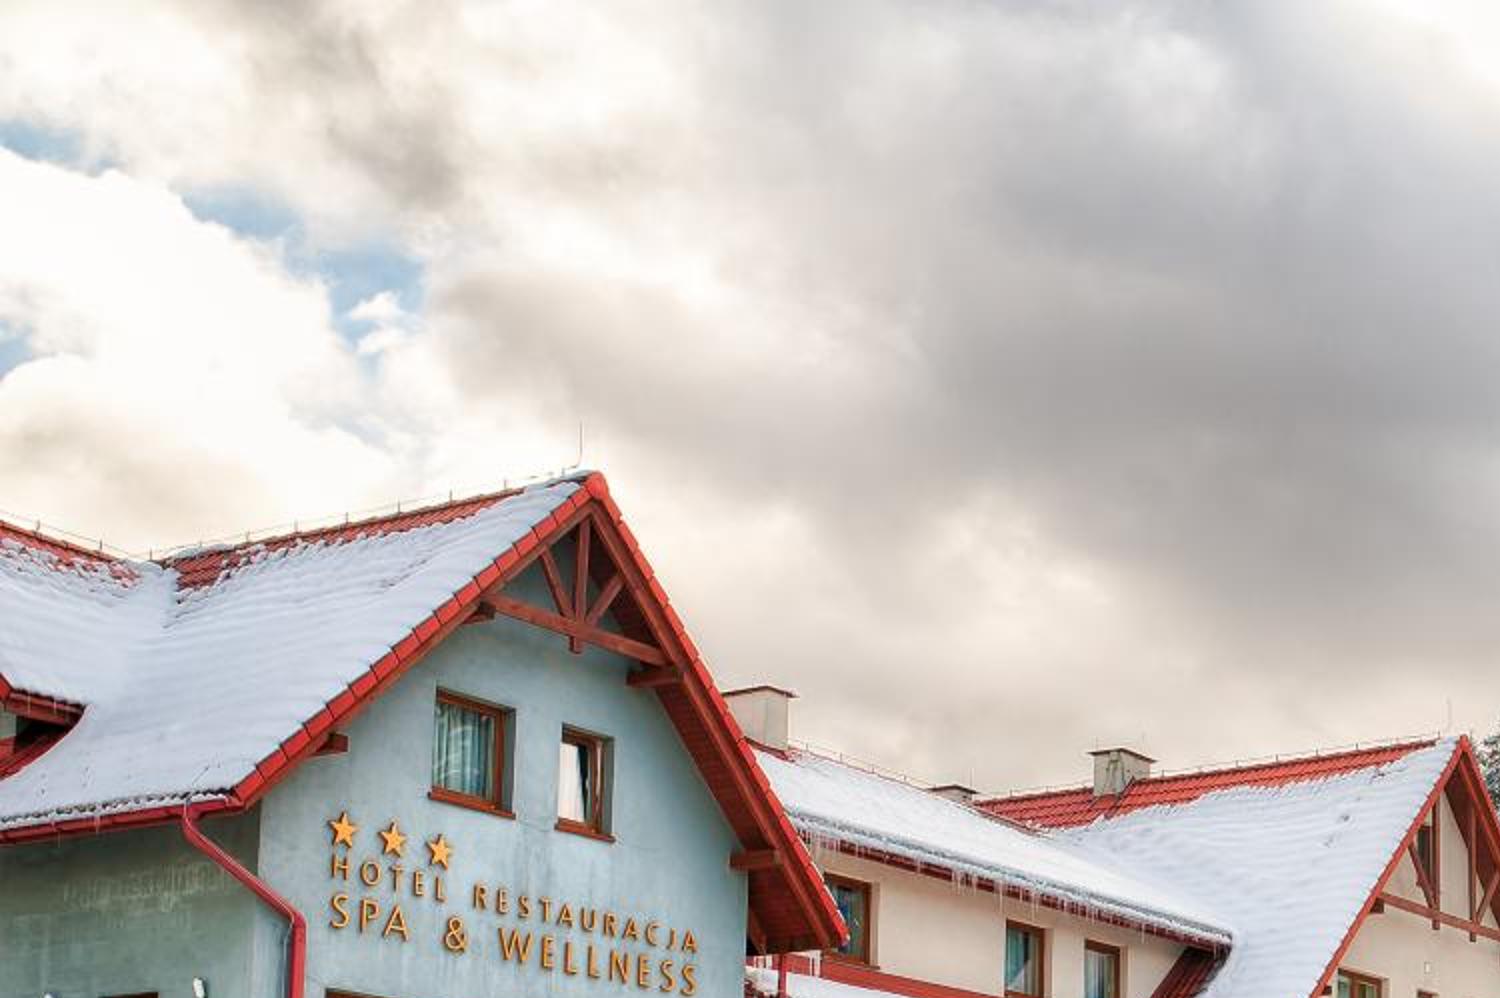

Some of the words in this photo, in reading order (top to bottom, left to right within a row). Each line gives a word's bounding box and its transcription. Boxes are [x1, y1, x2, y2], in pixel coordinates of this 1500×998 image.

[330, 895, 410, 942] SPA
[444, 915, 469, 953] &
[499, 927, 699, 997] WELLNESS
[331, 854, 448, 902] HOTEL
[472, 881, 699, 953] RESTAURACJA
